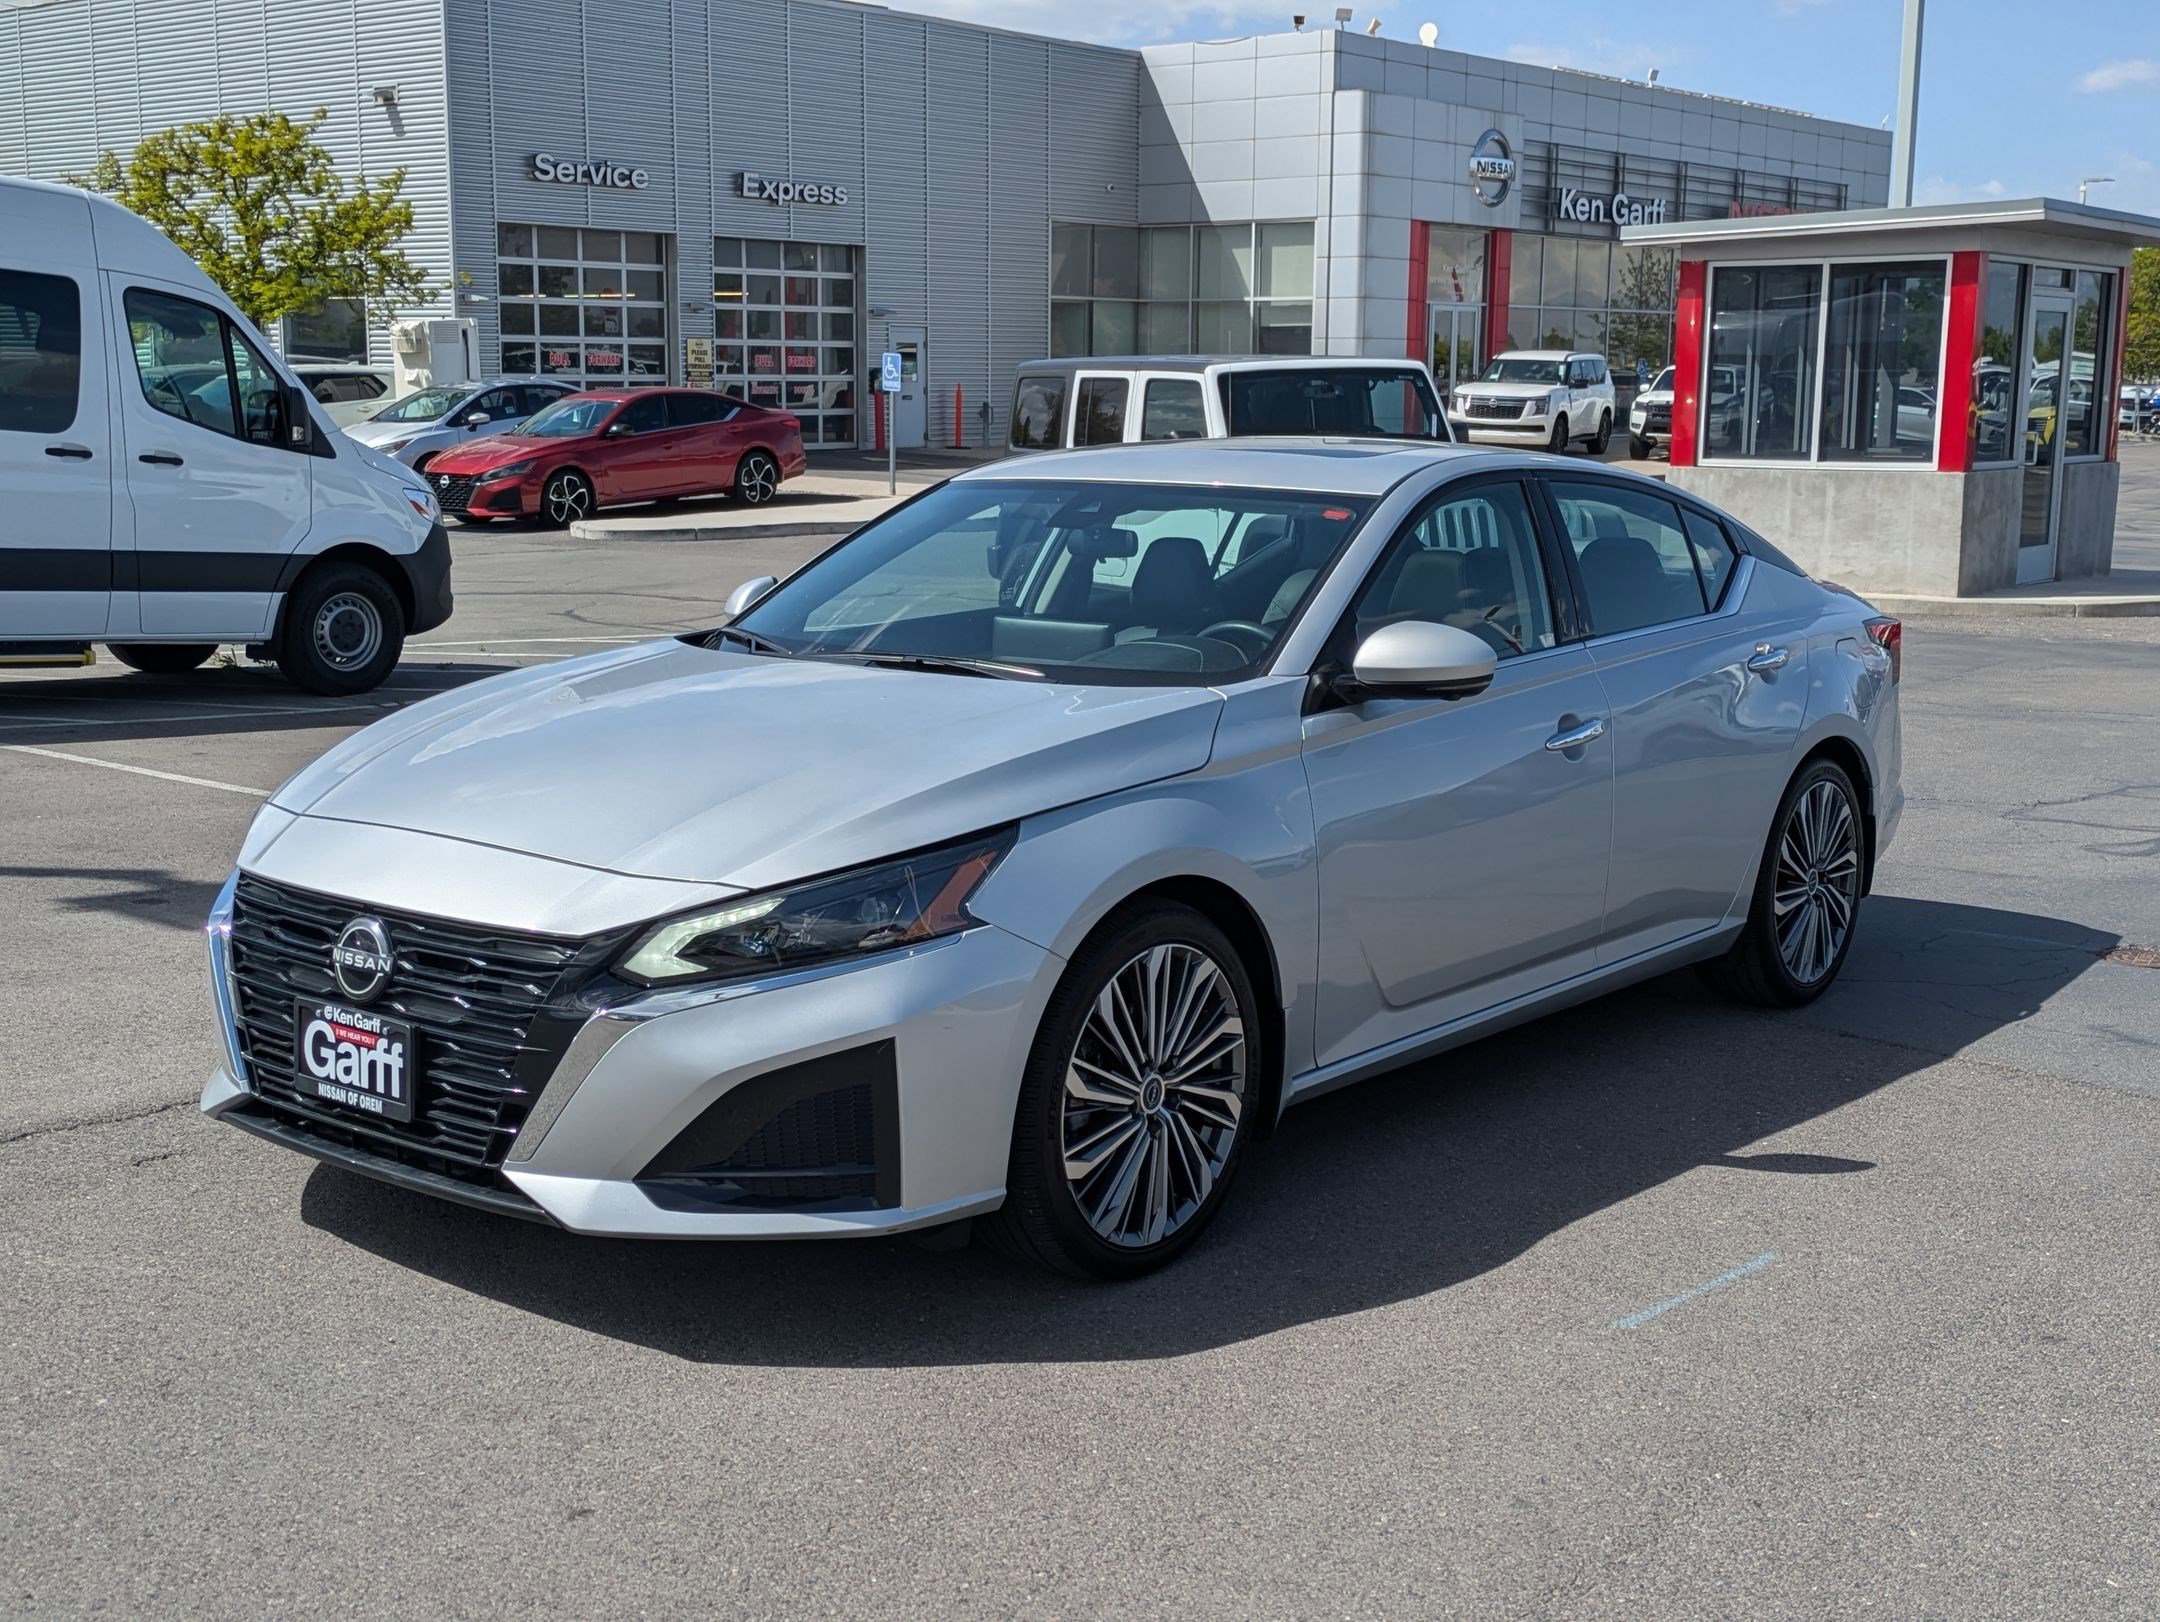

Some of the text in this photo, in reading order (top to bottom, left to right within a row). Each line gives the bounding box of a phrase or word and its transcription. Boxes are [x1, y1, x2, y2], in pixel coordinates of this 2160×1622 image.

[534, 153, 649, 188] Service
[743, 172, 848, 205] Express
[1560, 187, 1666, 225] Ken Garff
[549, 351, 621, 366] PULL FORWARD
[754, 354, 816, 368] PULL FORWARD
[332, 947, 391, 972] NISSAN
[333, 1007, 381, 1033] Ken Garff
[340, 1029, 372, 1044] WE HEAR YOU
[304, 1020, 404, 1098] Garff
[318, 1082, 383, 1114] NISSAN OF OREM
